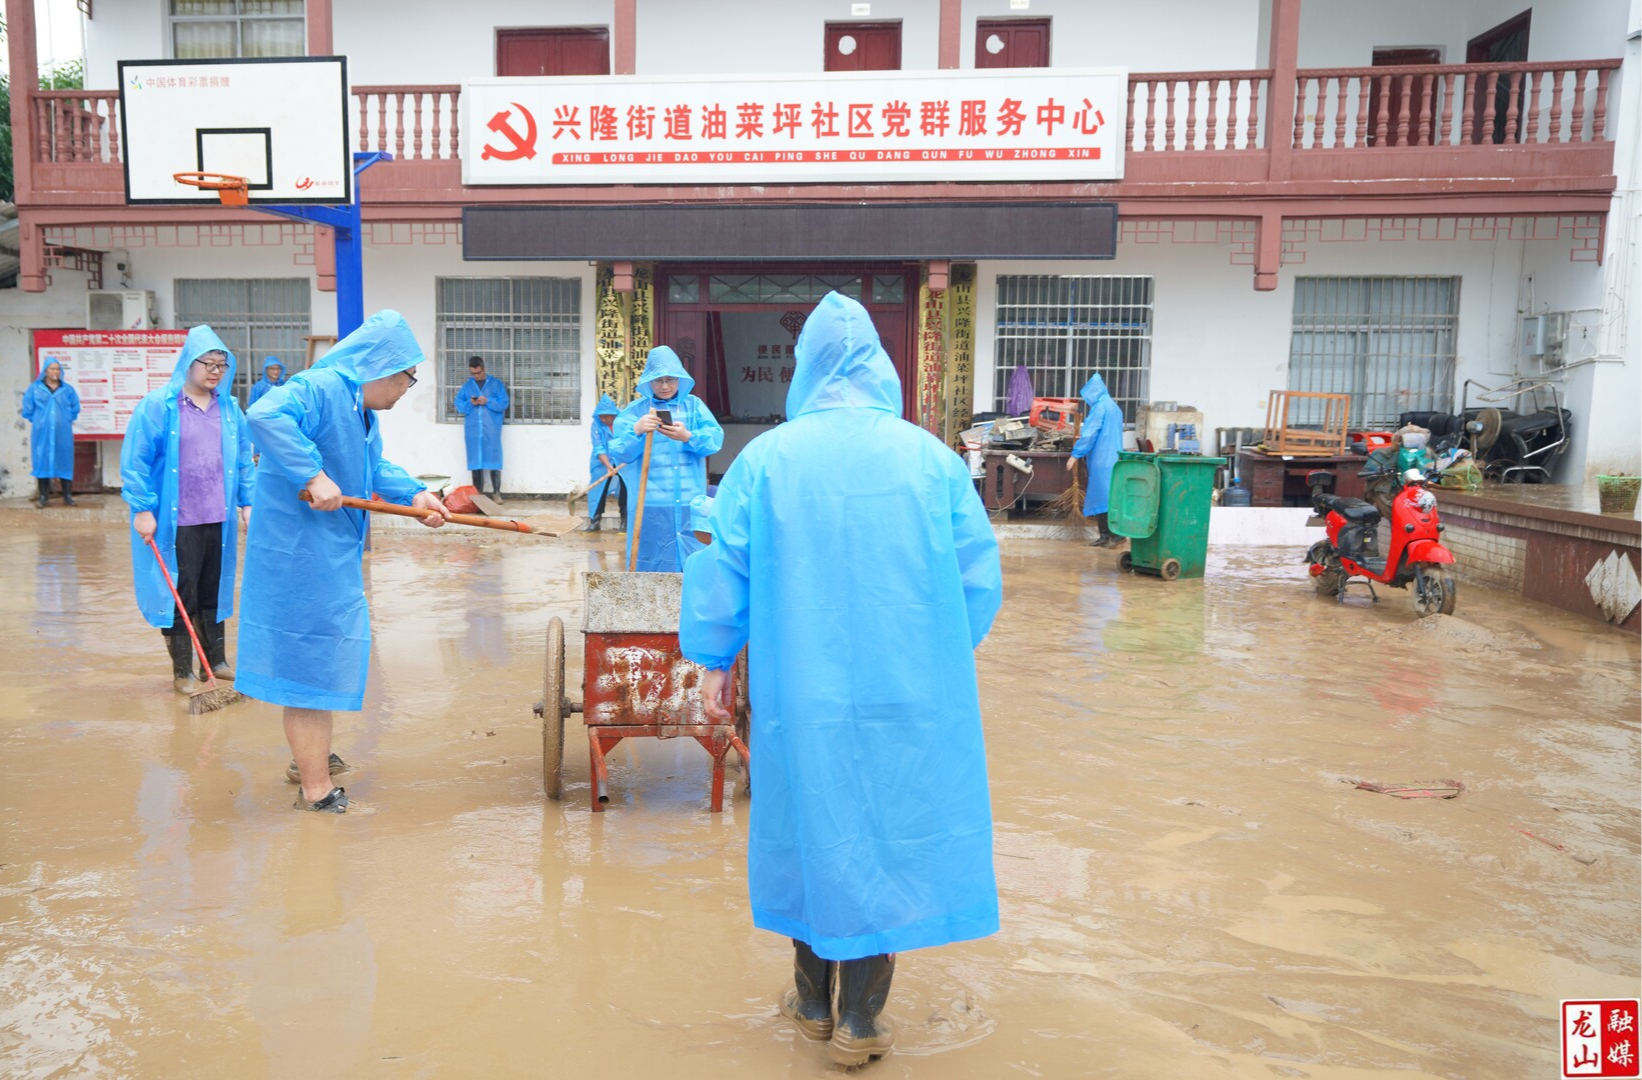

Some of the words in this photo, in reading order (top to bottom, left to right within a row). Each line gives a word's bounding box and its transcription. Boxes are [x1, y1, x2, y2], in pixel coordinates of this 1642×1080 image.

[552, 98, 1104, 140] 兴隆街道油菜坪社区党群服务中心
[562, 153, 591, 163] XING
[603, 153, 635, 162] LONG
[645, 152, 663, 162] JIE
[674, 152, 698, 162] DAO
[709, 152, 733, 161] YOU
[744, 151, 764, 161] CAI
[774, 151, 803, 161] PING
[815, 151, 837, 160] SHE
[849, 150, 866, 160] QU
[877, 150, 910, 159] DANG
[921, 149, 947, 159] QUN
[958, 149, 973, 159] FU
[984, 149, 1003, 158] WU
[1014, 148, 1056, 158] ZHONG
[1068, 148, 1090, 157] XIN
